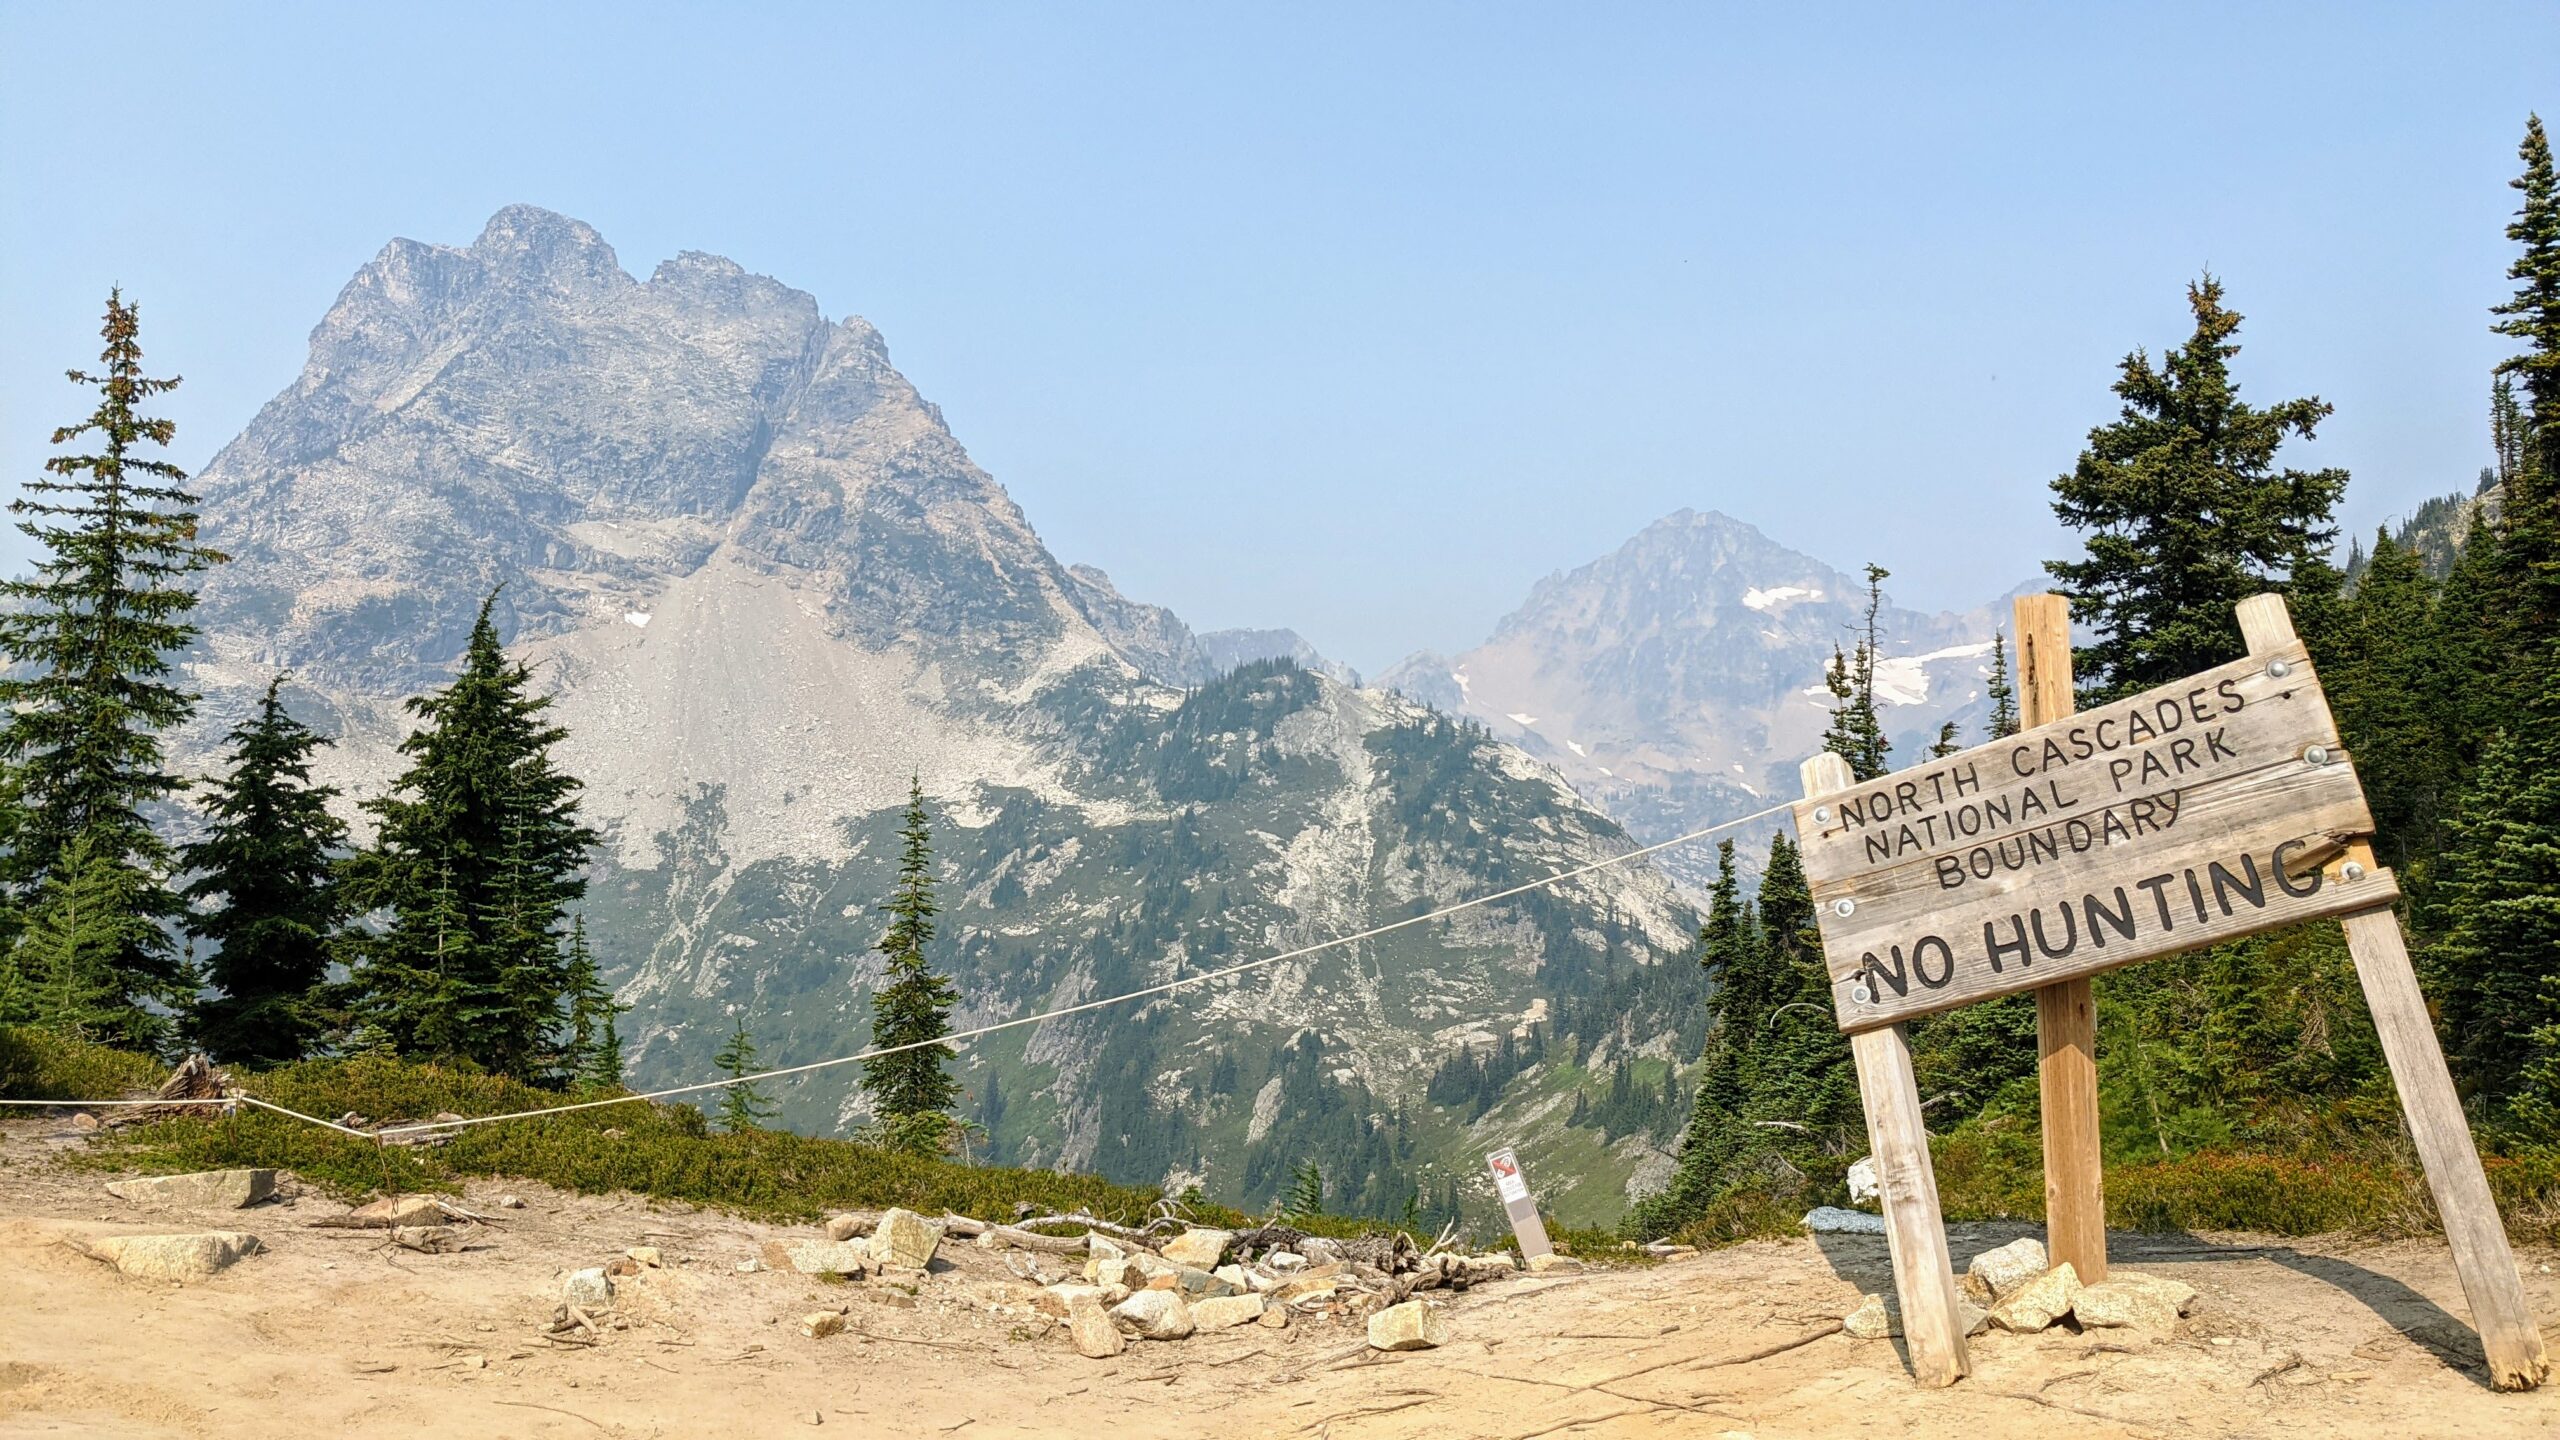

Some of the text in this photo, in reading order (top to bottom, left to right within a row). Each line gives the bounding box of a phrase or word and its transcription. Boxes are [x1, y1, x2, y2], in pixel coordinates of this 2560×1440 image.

[1839, 680, 2246, 832] NORTH CASCADES
[1864, 727, 2237, 864] NATIONAL PARK
[1936, 789, 2180, 890] BOUNDARY
[1861, 839, 2323, 1004] NO HUNTING
